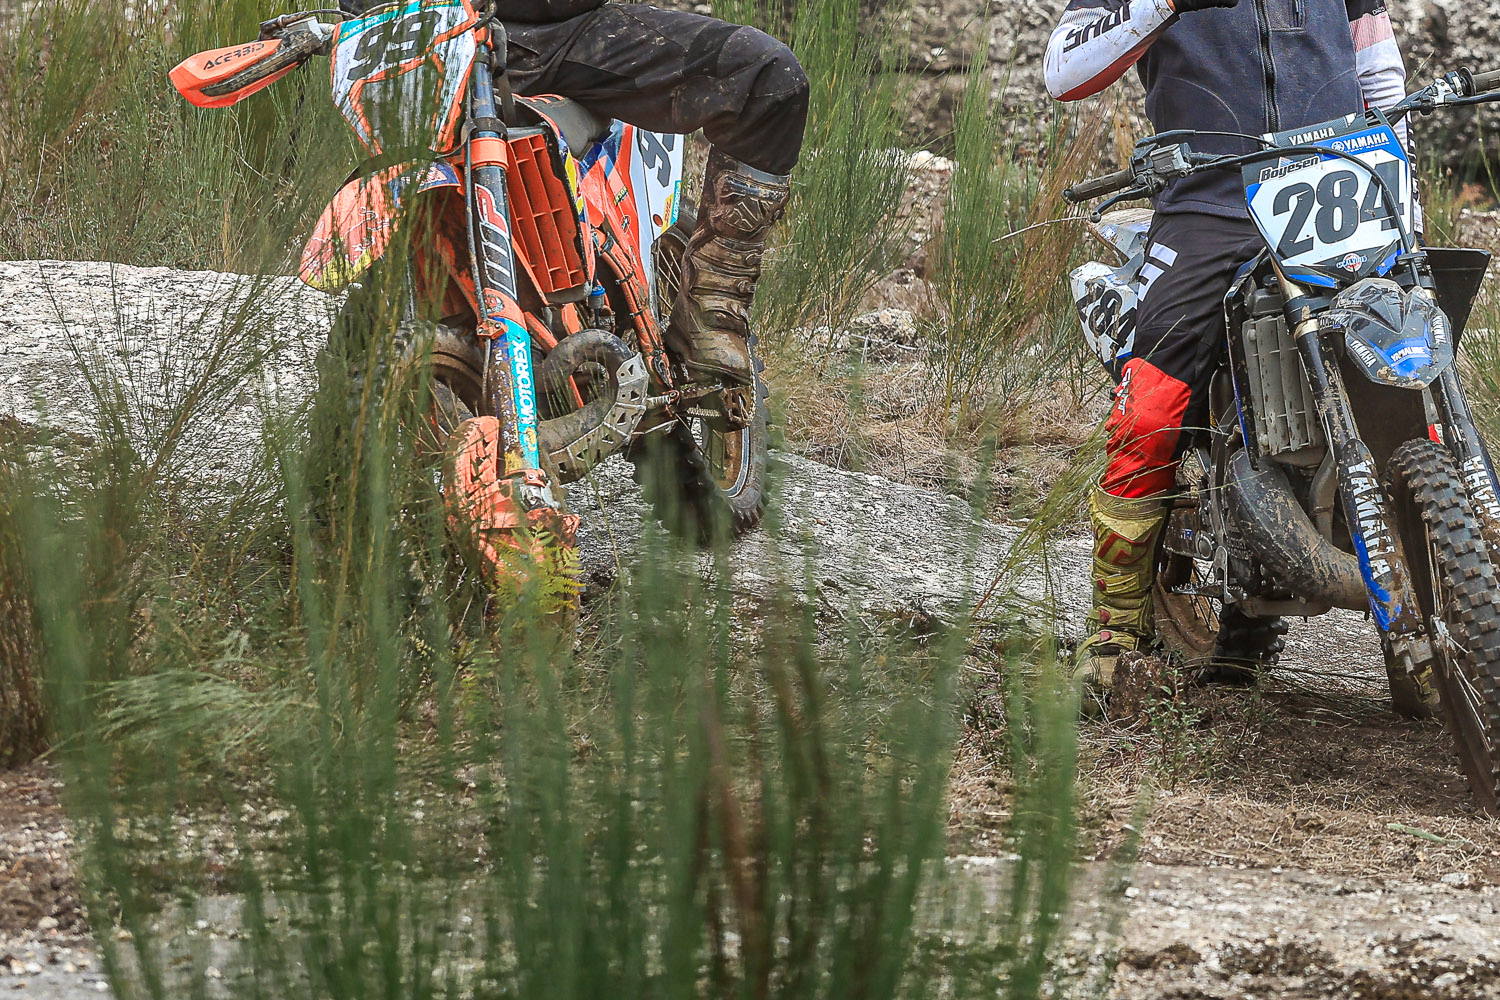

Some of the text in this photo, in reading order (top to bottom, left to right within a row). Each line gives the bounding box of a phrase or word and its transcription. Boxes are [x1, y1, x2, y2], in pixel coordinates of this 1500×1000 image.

[1288, 127, 1336, 147] YAMAHA
[1343, 131, 1390, 150] YAMAHA
[1260, 156, 1320, 183] Boyesen
[1272, 159, 1405, 259] 284
[1349, 340, 1378, 369] YAMAHA
[511, 340, 537, 426] MOTOREX
